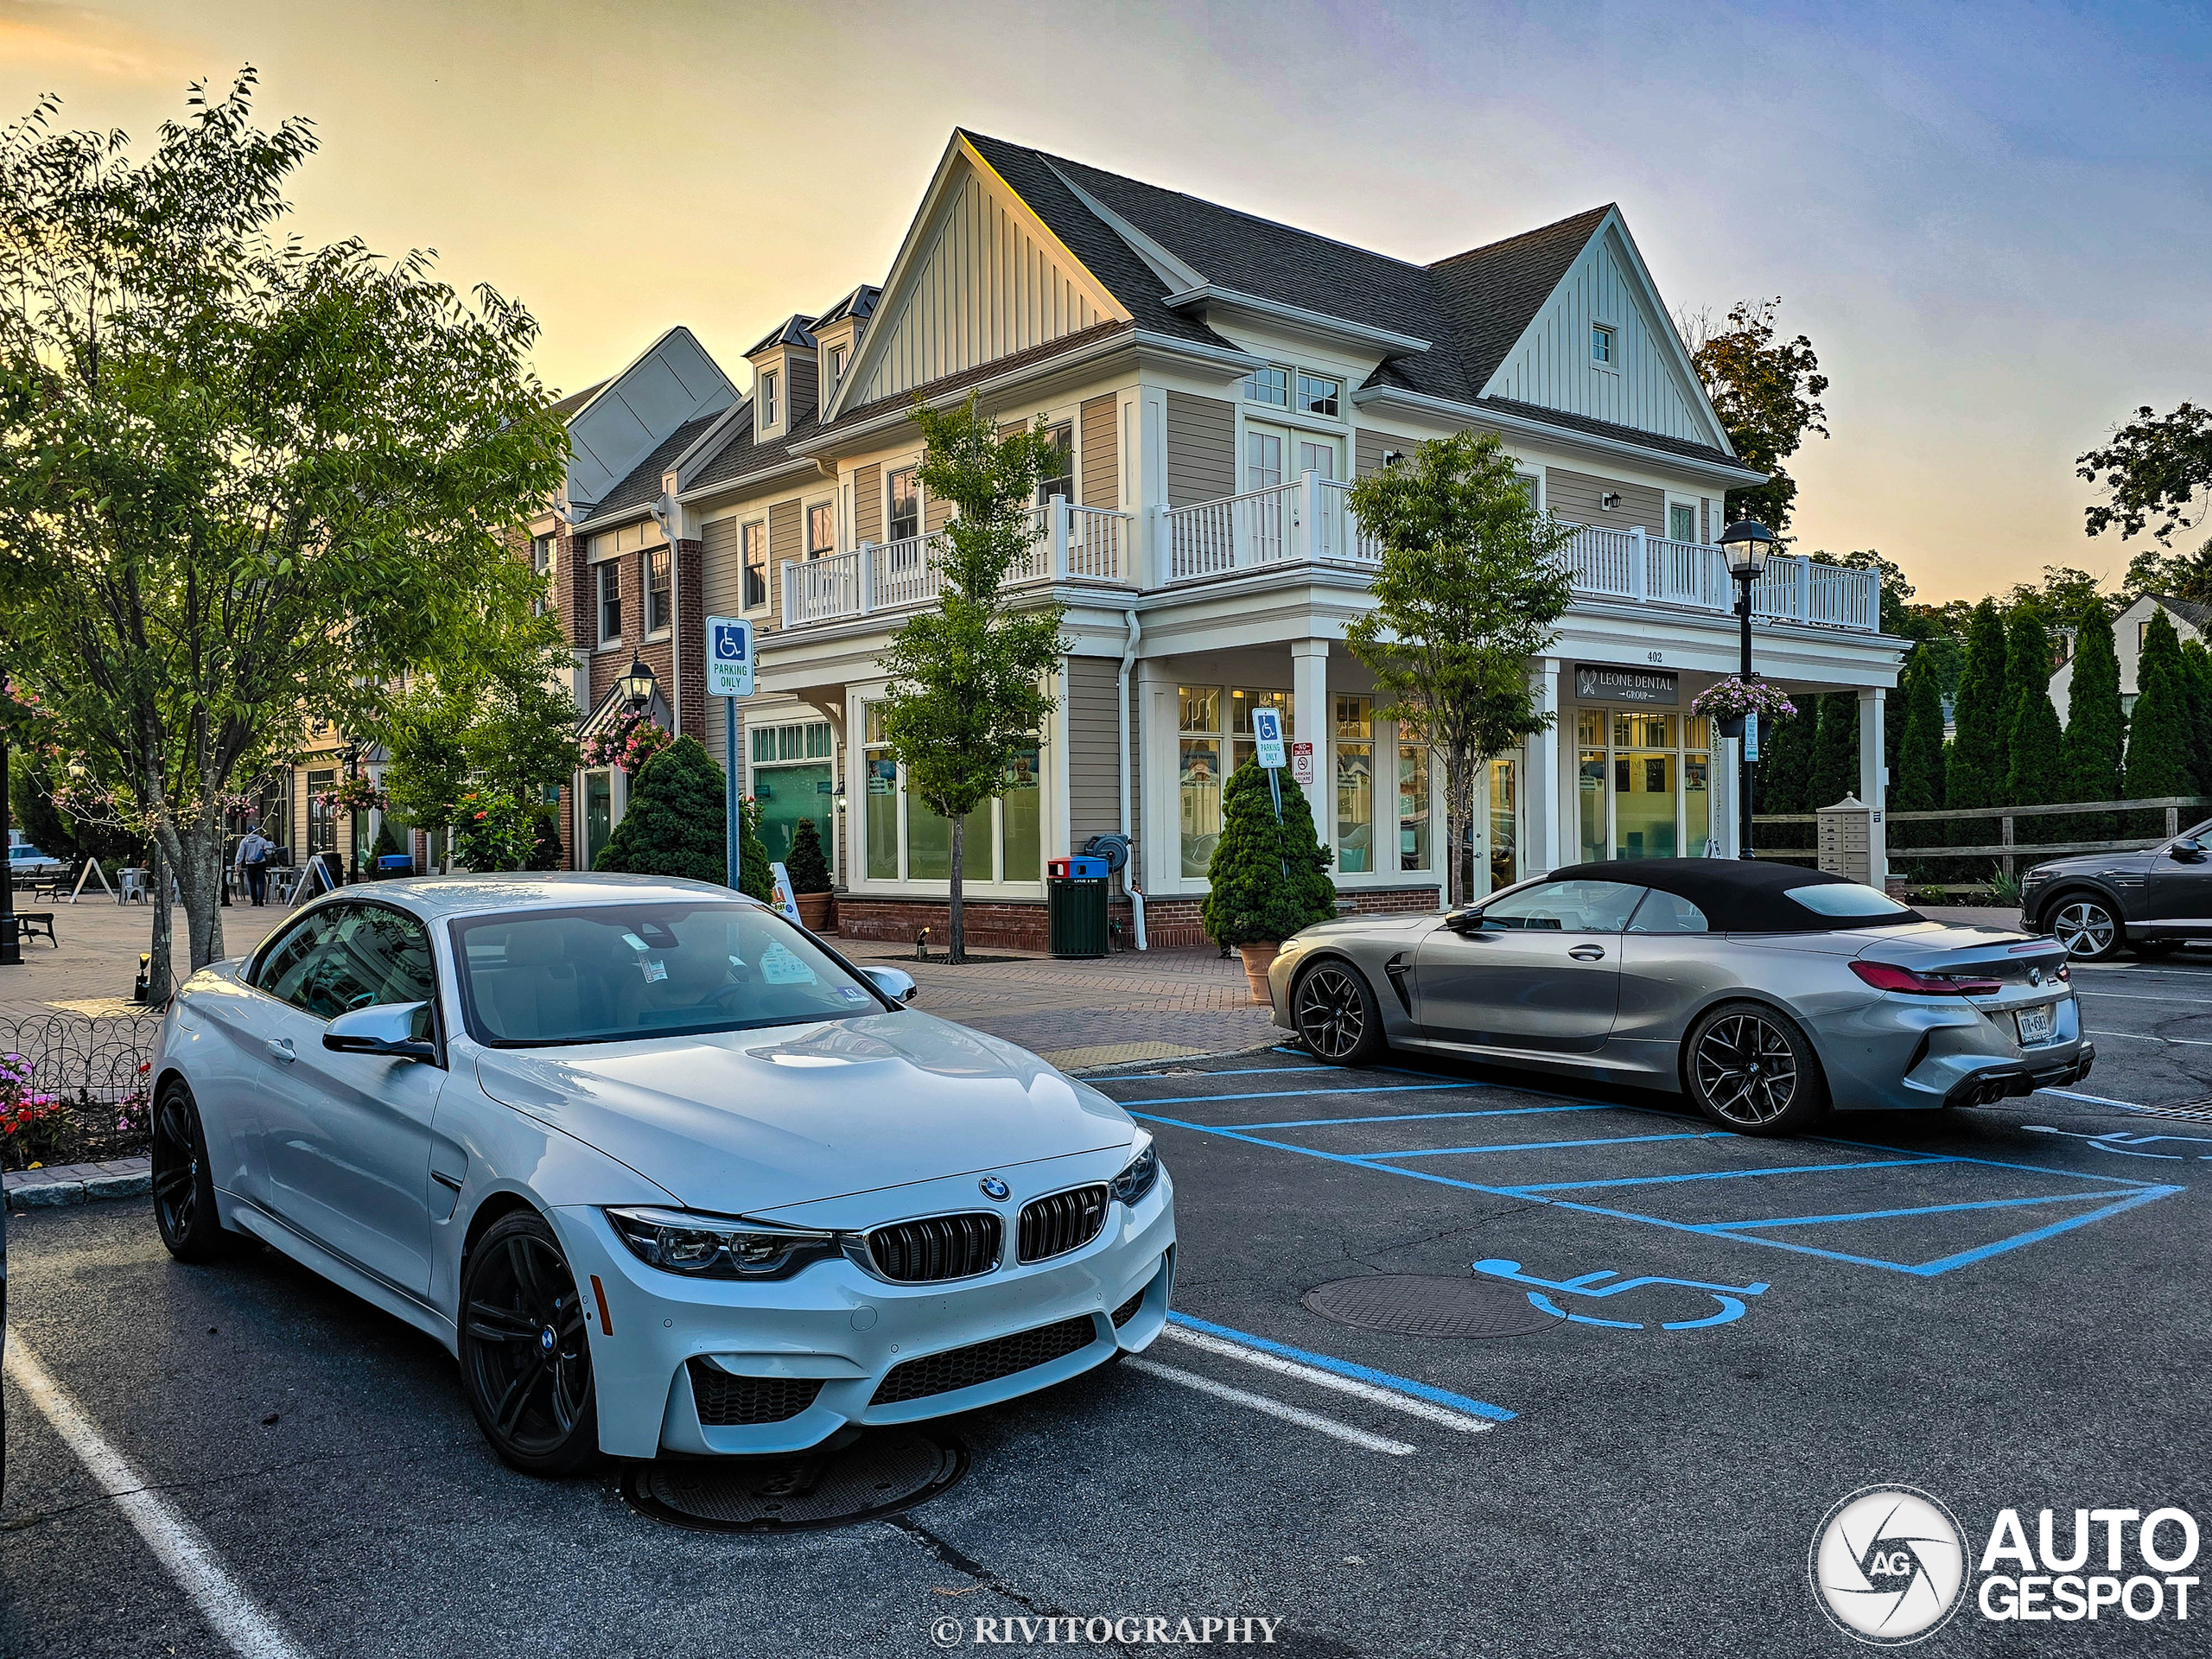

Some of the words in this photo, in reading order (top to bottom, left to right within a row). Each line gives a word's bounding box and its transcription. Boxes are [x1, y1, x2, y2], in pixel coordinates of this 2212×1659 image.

[1647, 652, 1662, 663] 402
[714, 663, 747, 676] PARKING
[721, 676, 741, 688] ONLY
[1600, 672, 1633, 687] LEONE
[1635, 676, 1673, 690] DENTAL
[1625, 690, 1648, 700] GROUP
[1266, 753, 1278, 761] ONLY
